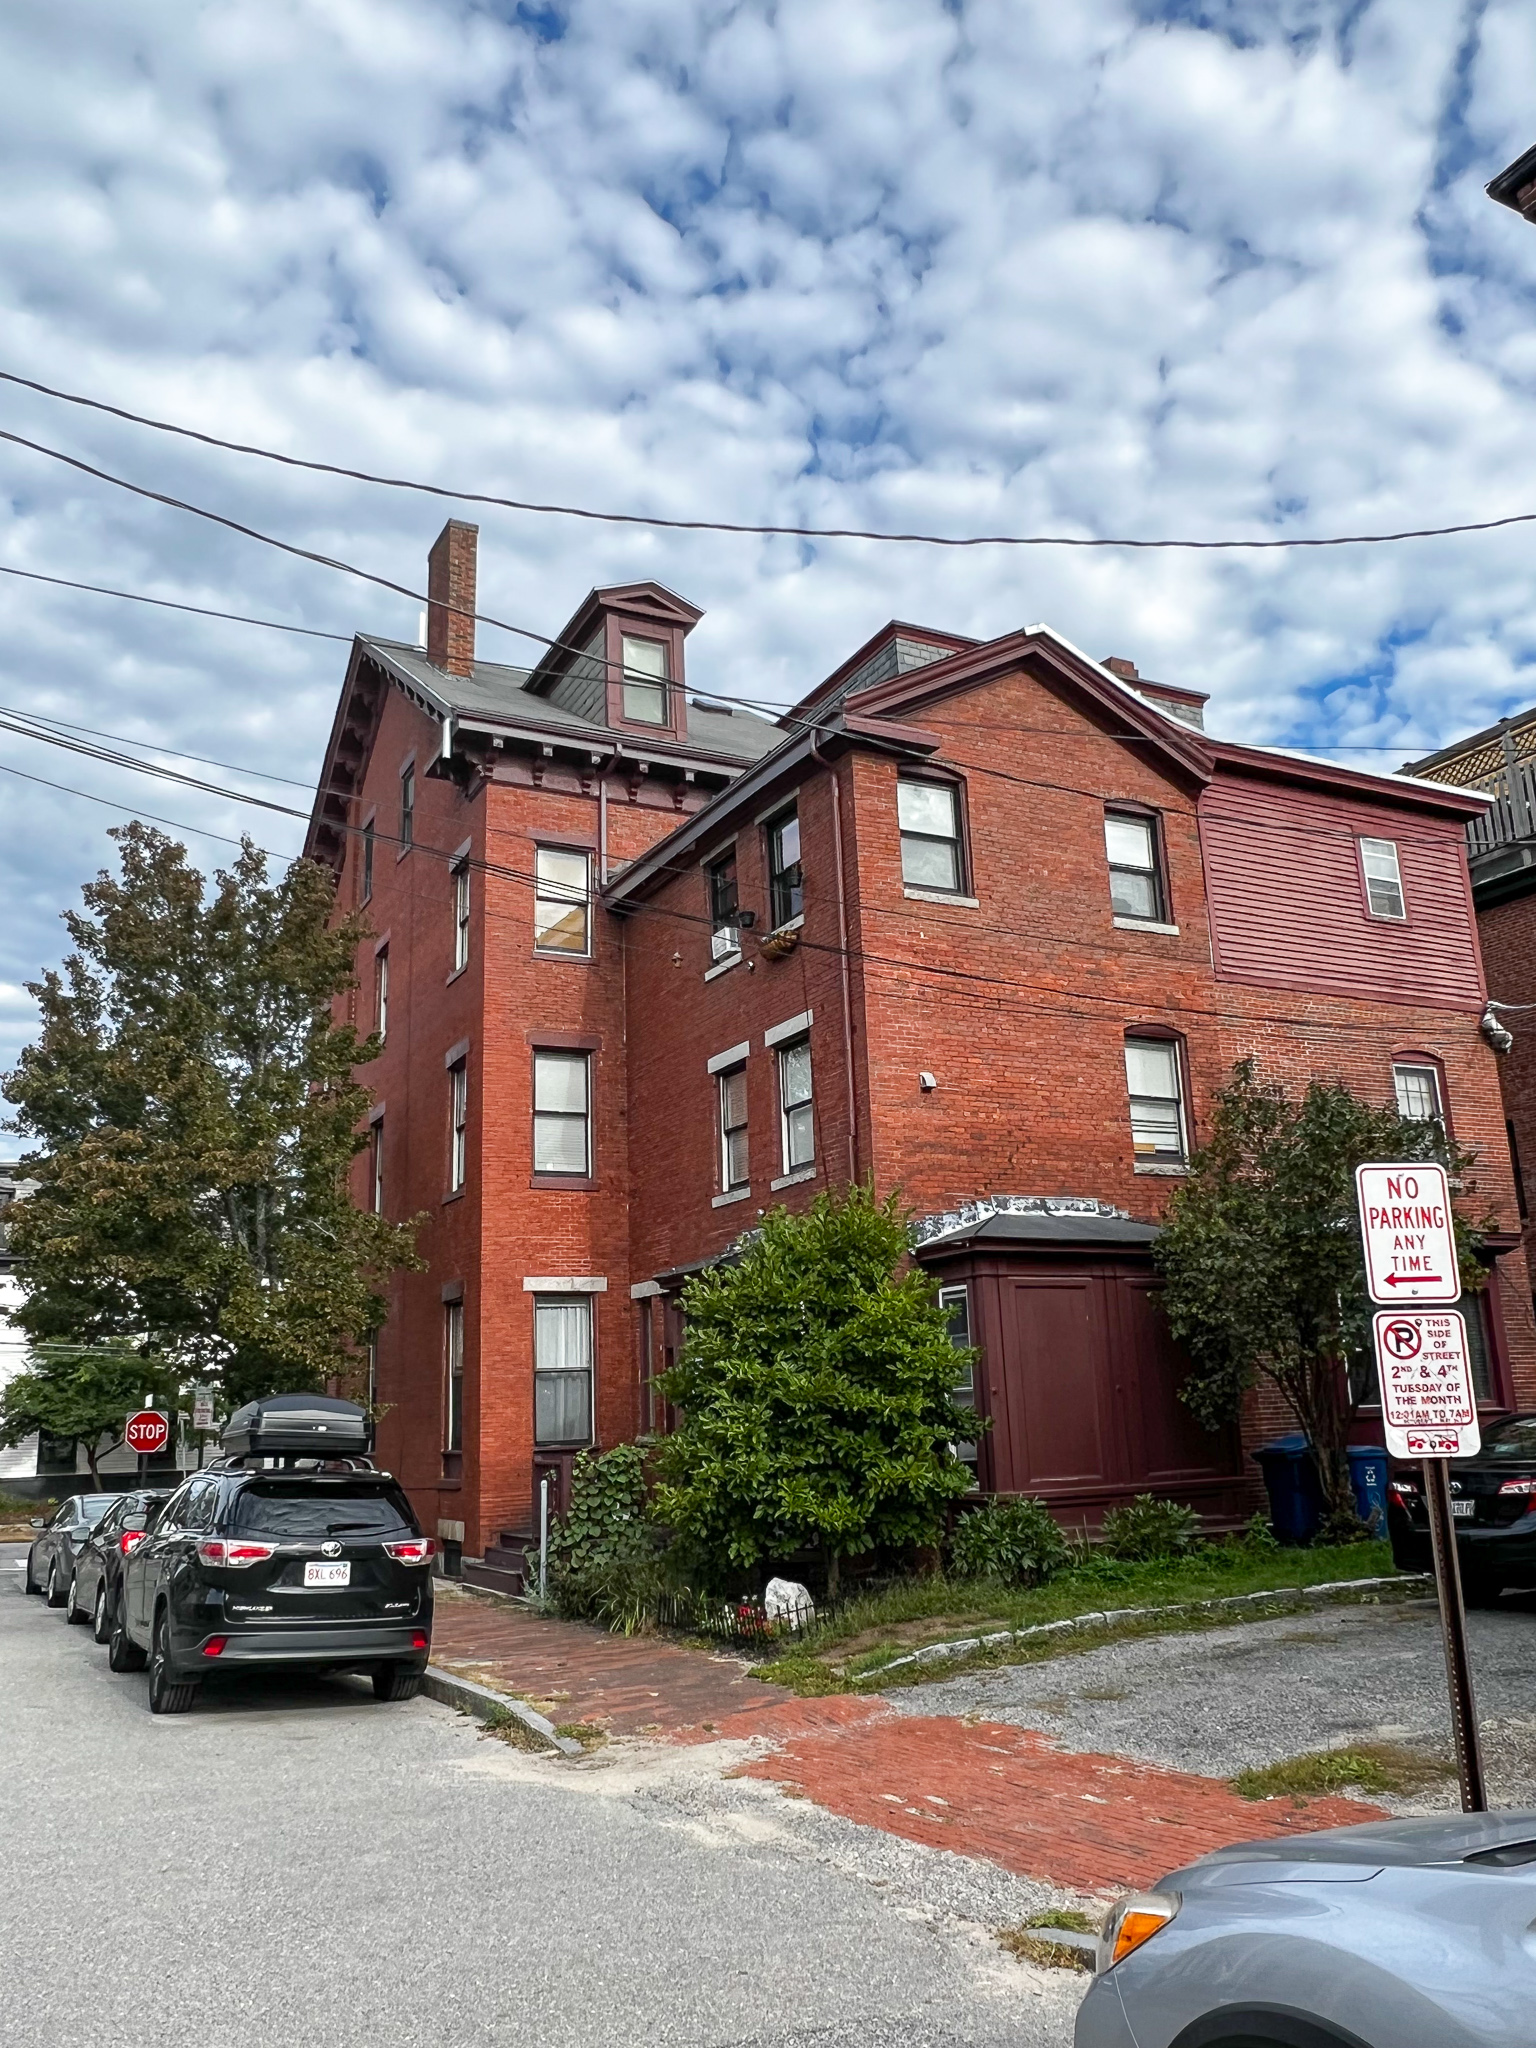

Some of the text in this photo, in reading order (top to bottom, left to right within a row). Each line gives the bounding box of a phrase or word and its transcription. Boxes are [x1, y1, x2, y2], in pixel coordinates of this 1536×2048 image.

[1387, 1177, 1419, 1199] NO
[1369, 1206, 1444, 1229] PARKING
[1393, 1235, 1425, 1251] ANY
[1391, 1256, 1433, 1271] TIME
[1425, 1318, 1451, 1328] THIS
[1427, 1329, 1452, 1338] SIDE
[1433, 1340, 1447, 1349] OF
[1422, 1351, 1461, 1360] STREET
[1391, 1365, 1459, 1379] 2ND & 4TH
[1392, 1383, 1460, 1393] TUESDAY OF
[1395, 1395, 1462, 1405] THE MONTH
[1432, 1409, 1446, 1418] TO
[1449, 1409, 1469, 1418] 7AM
[129, 1424, 165, 1440] STOP
[308, 1568, 348, 1580] 8XL 696
